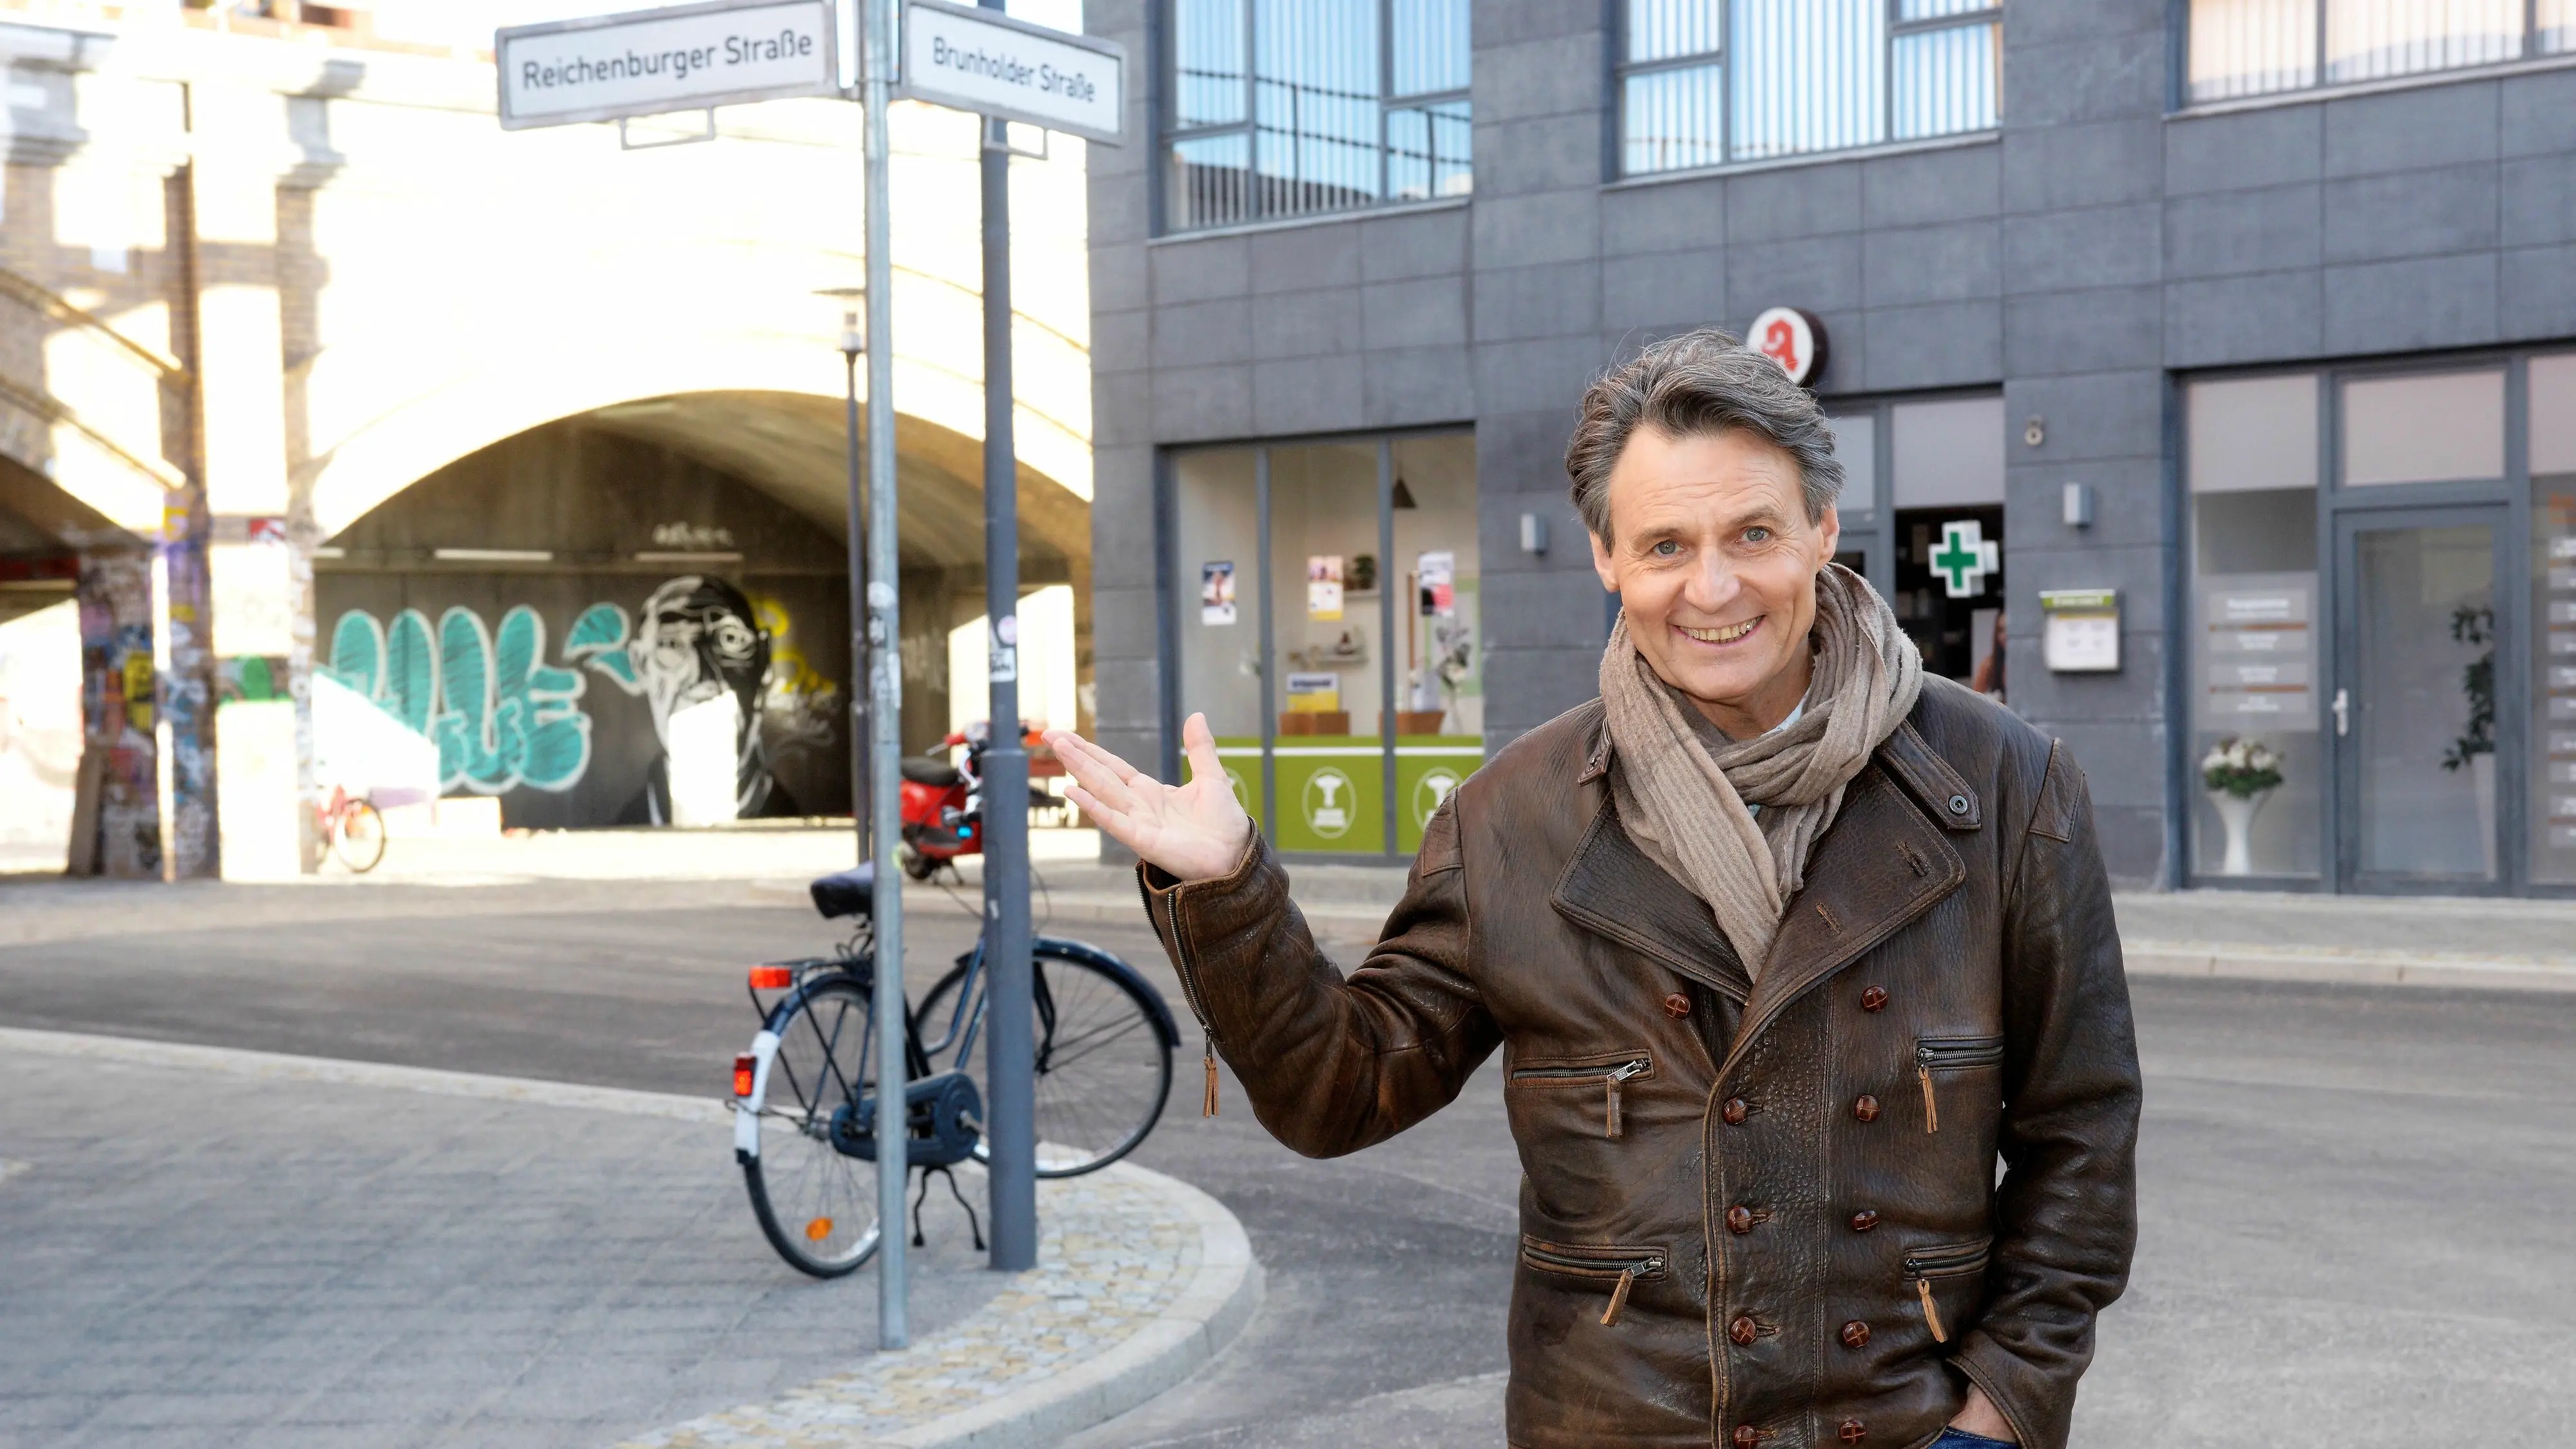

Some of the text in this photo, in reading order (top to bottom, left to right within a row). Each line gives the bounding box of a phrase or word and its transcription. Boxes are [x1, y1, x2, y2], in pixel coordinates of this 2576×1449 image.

[524, 30, 813, 90] Reichenburger Straße
[934, 36, 1095, 102] Brunholder Straße
